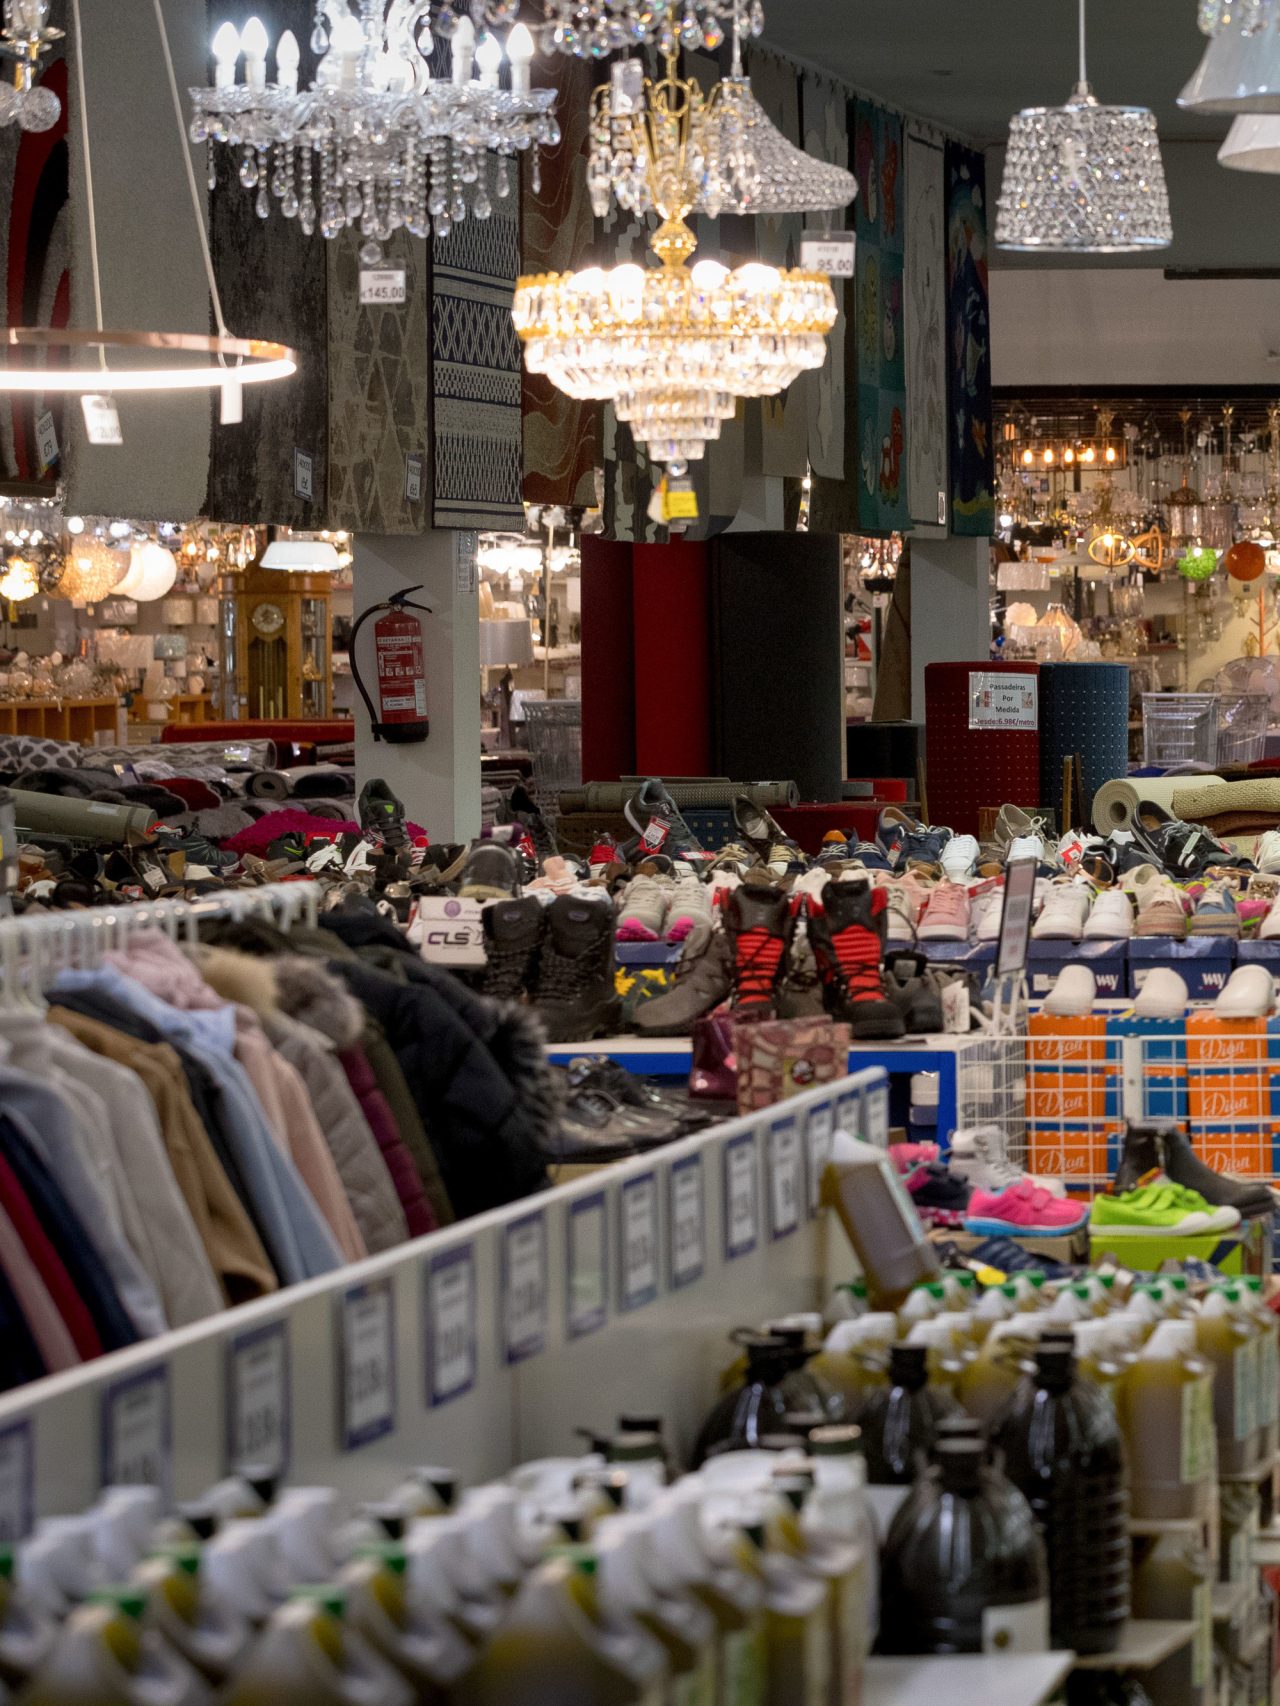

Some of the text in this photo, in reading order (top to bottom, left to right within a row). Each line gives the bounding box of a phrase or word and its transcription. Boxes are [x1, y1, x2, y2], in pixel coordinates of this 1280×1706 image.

[989, 683, 1026, 691] Passadeiras
[1002, 694, 1013, 702] Por
[427, 931, 471, 945] CLS
